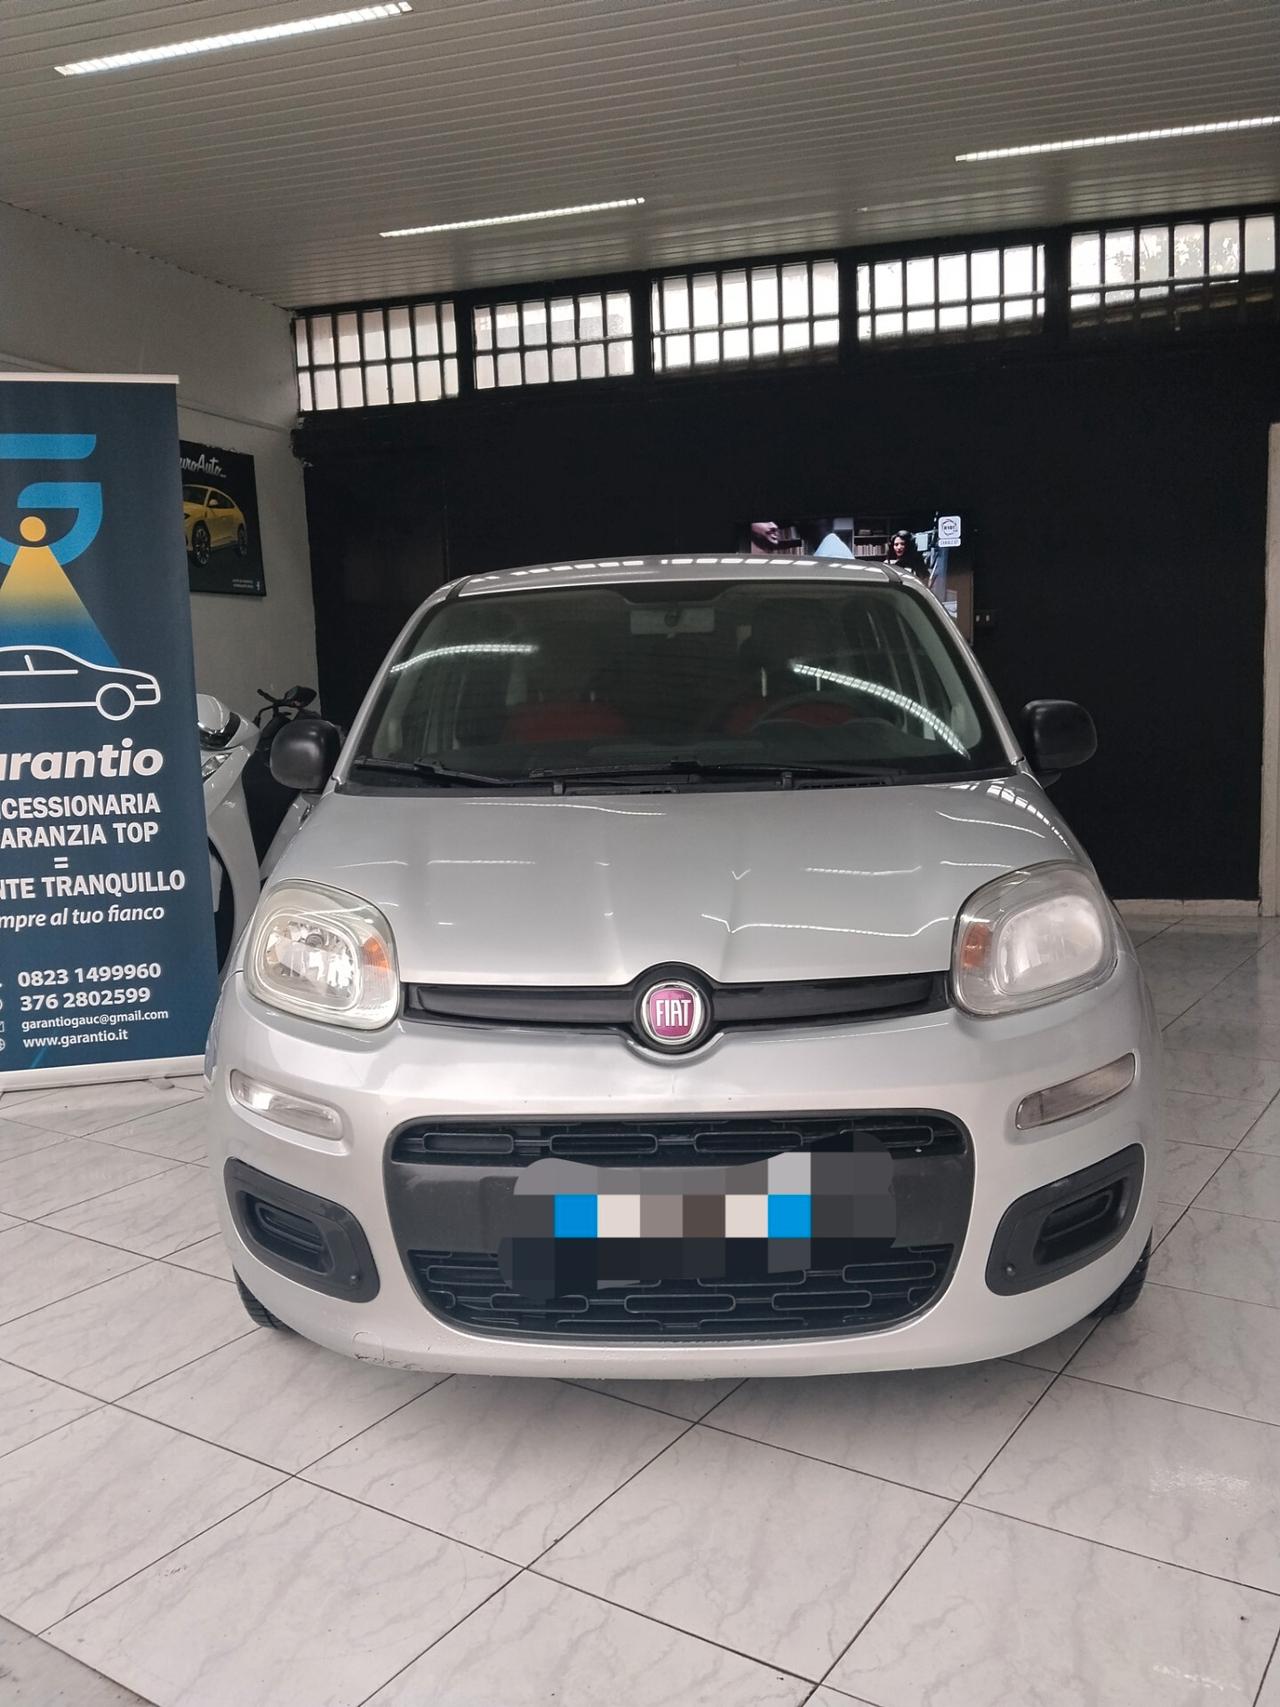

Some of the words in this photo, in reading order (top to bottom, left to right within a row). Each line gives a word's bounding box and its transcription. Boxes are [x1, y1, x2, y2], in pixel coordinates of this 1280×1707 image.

[0, 737, 164, 781] rantio
[0, 792, 161, 820] CESSIONARIA
[112, 822, 159, 844] TOP
[41, 869, 186, 898] TRANQUILLO
[50, 907, 69, 927] al
[71, 907, 104, 925] tuo
[107, 904, 165, 924] fianco
[17, 968, 70, 988] 0823
[74, 962, 162, 983] 1499960
[19, 994, 60, 1012] 376
[63, 987, 151, 1008] 2802599
[21, 1009, 169, 1032] garantiogauc@gmail.com
[656, 999, 692, 1027] FIAT
[23, 1029, 129, 1048] www.garantio.it
